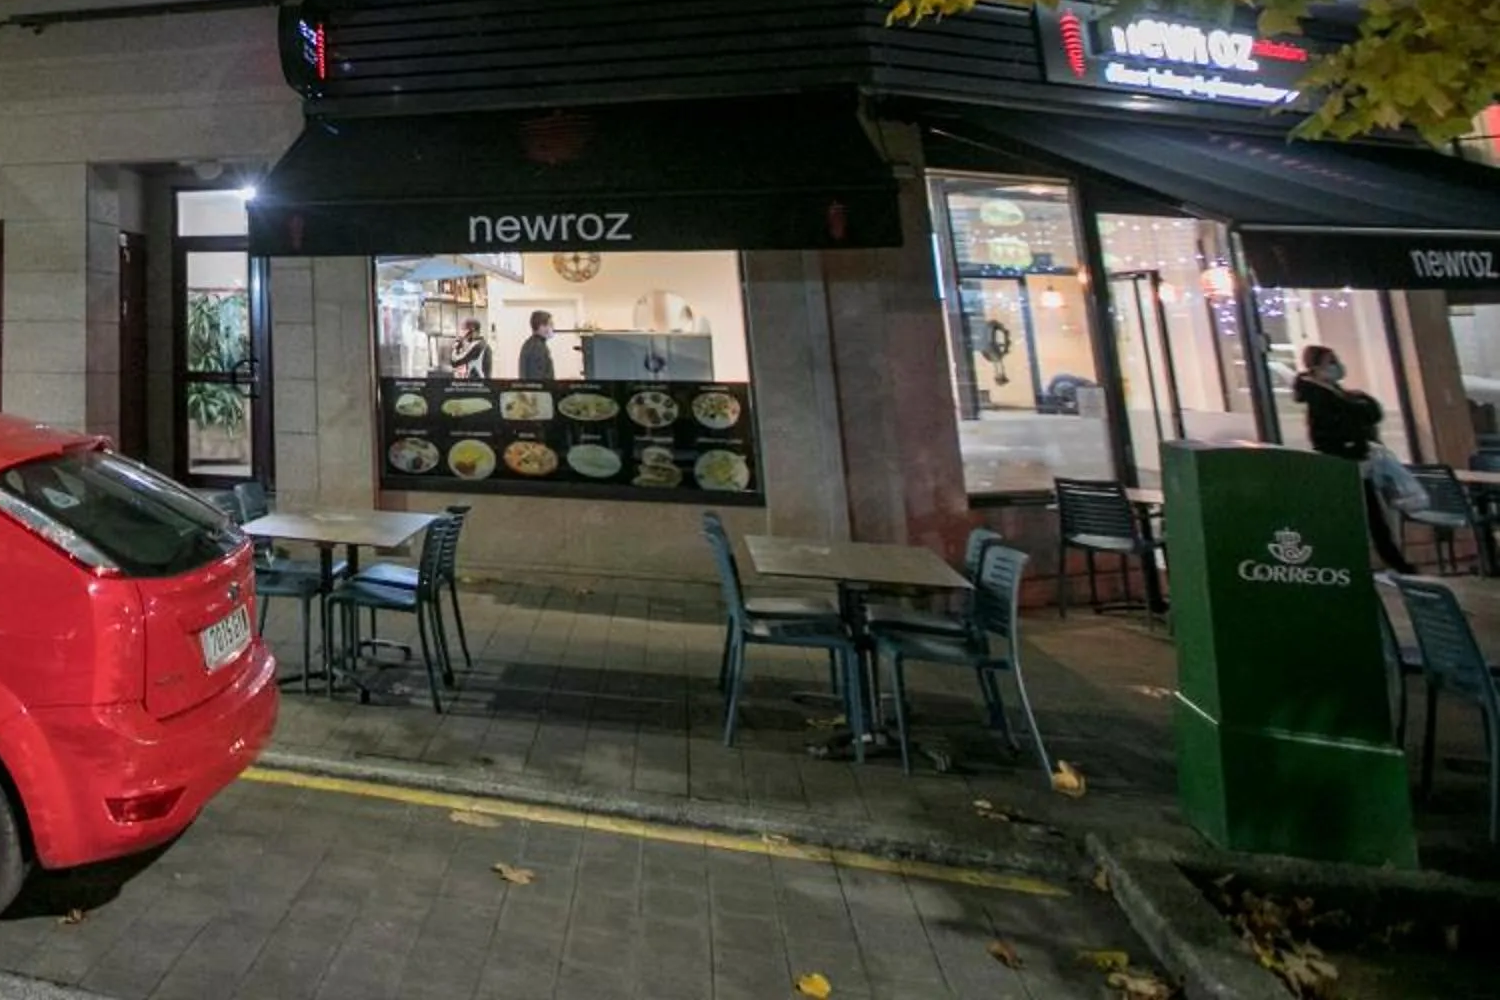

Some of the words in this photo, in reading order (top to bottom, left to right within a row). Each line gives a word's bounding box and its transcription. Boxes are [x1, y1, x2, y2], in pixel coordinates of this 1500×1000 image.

[468, 213, 632, 243] newroz
[1410, 250, 1500, 278] newroz
[1238, 559, 1351, 586] CORREOS
